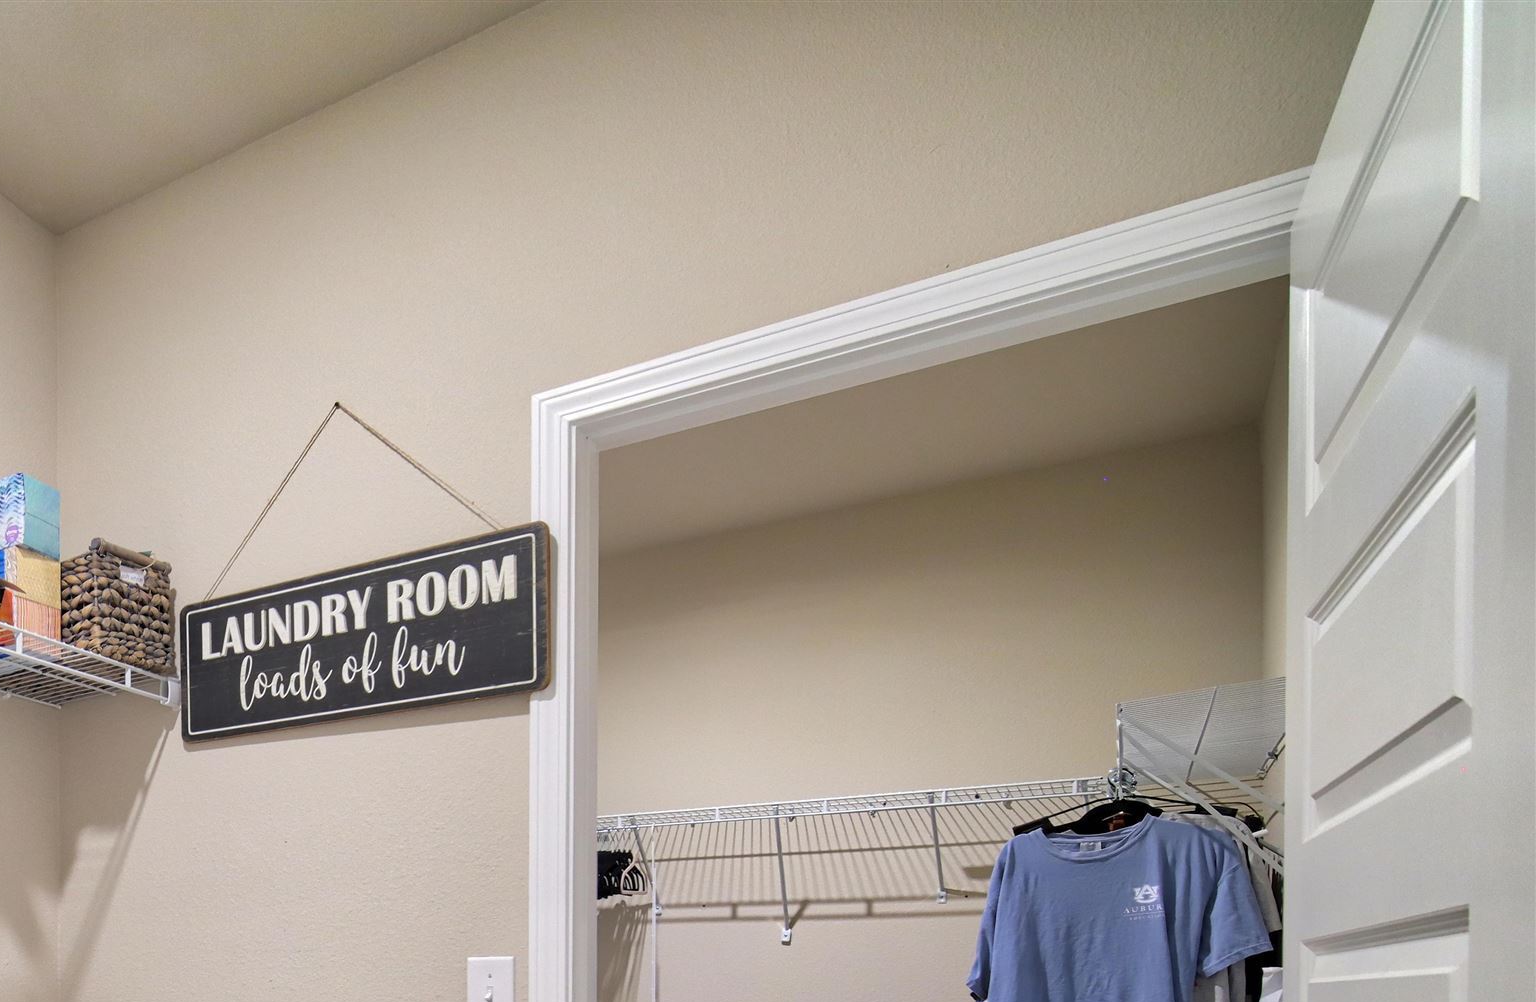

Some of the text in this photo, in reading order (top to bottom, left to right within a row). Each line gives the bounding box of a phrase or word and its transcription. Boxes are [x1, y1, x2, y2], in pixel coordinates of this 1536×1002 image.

[201, 553, 518, 661] LAUNDRY ROOM
[240, 626, 466, 712] loads of fun
[1123, 903, 1164, 914] AUBUR
